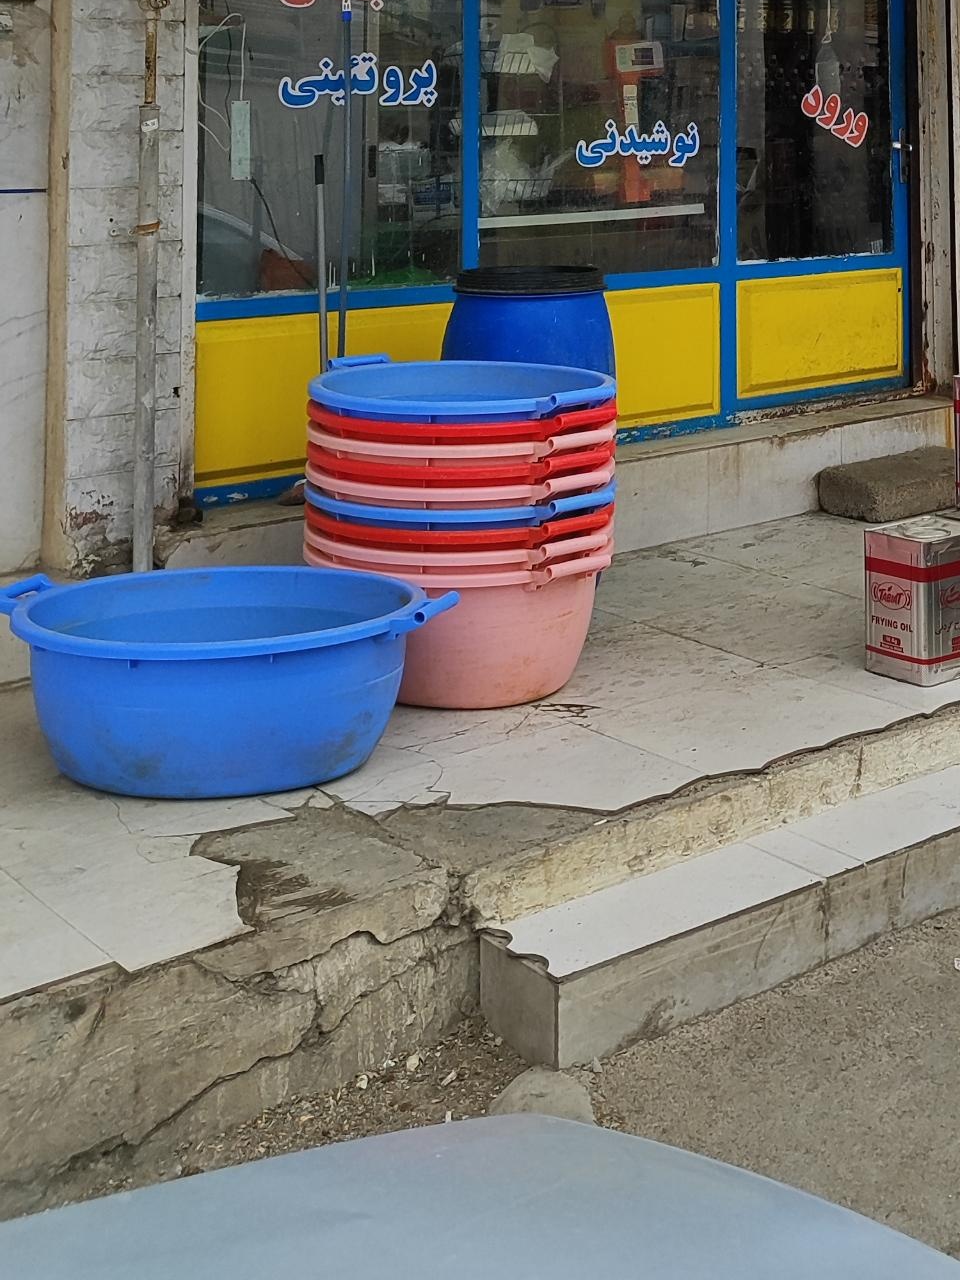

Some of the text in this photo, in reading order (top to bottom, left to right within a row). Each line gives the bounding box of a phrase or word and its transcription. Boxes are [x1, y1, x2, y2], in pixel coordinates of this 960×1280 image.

[801, 85, 868, 148] ورود
[576, 119, 699, 167] نوشیدنی
[871, 615, 914, 633] FRYING OIL
